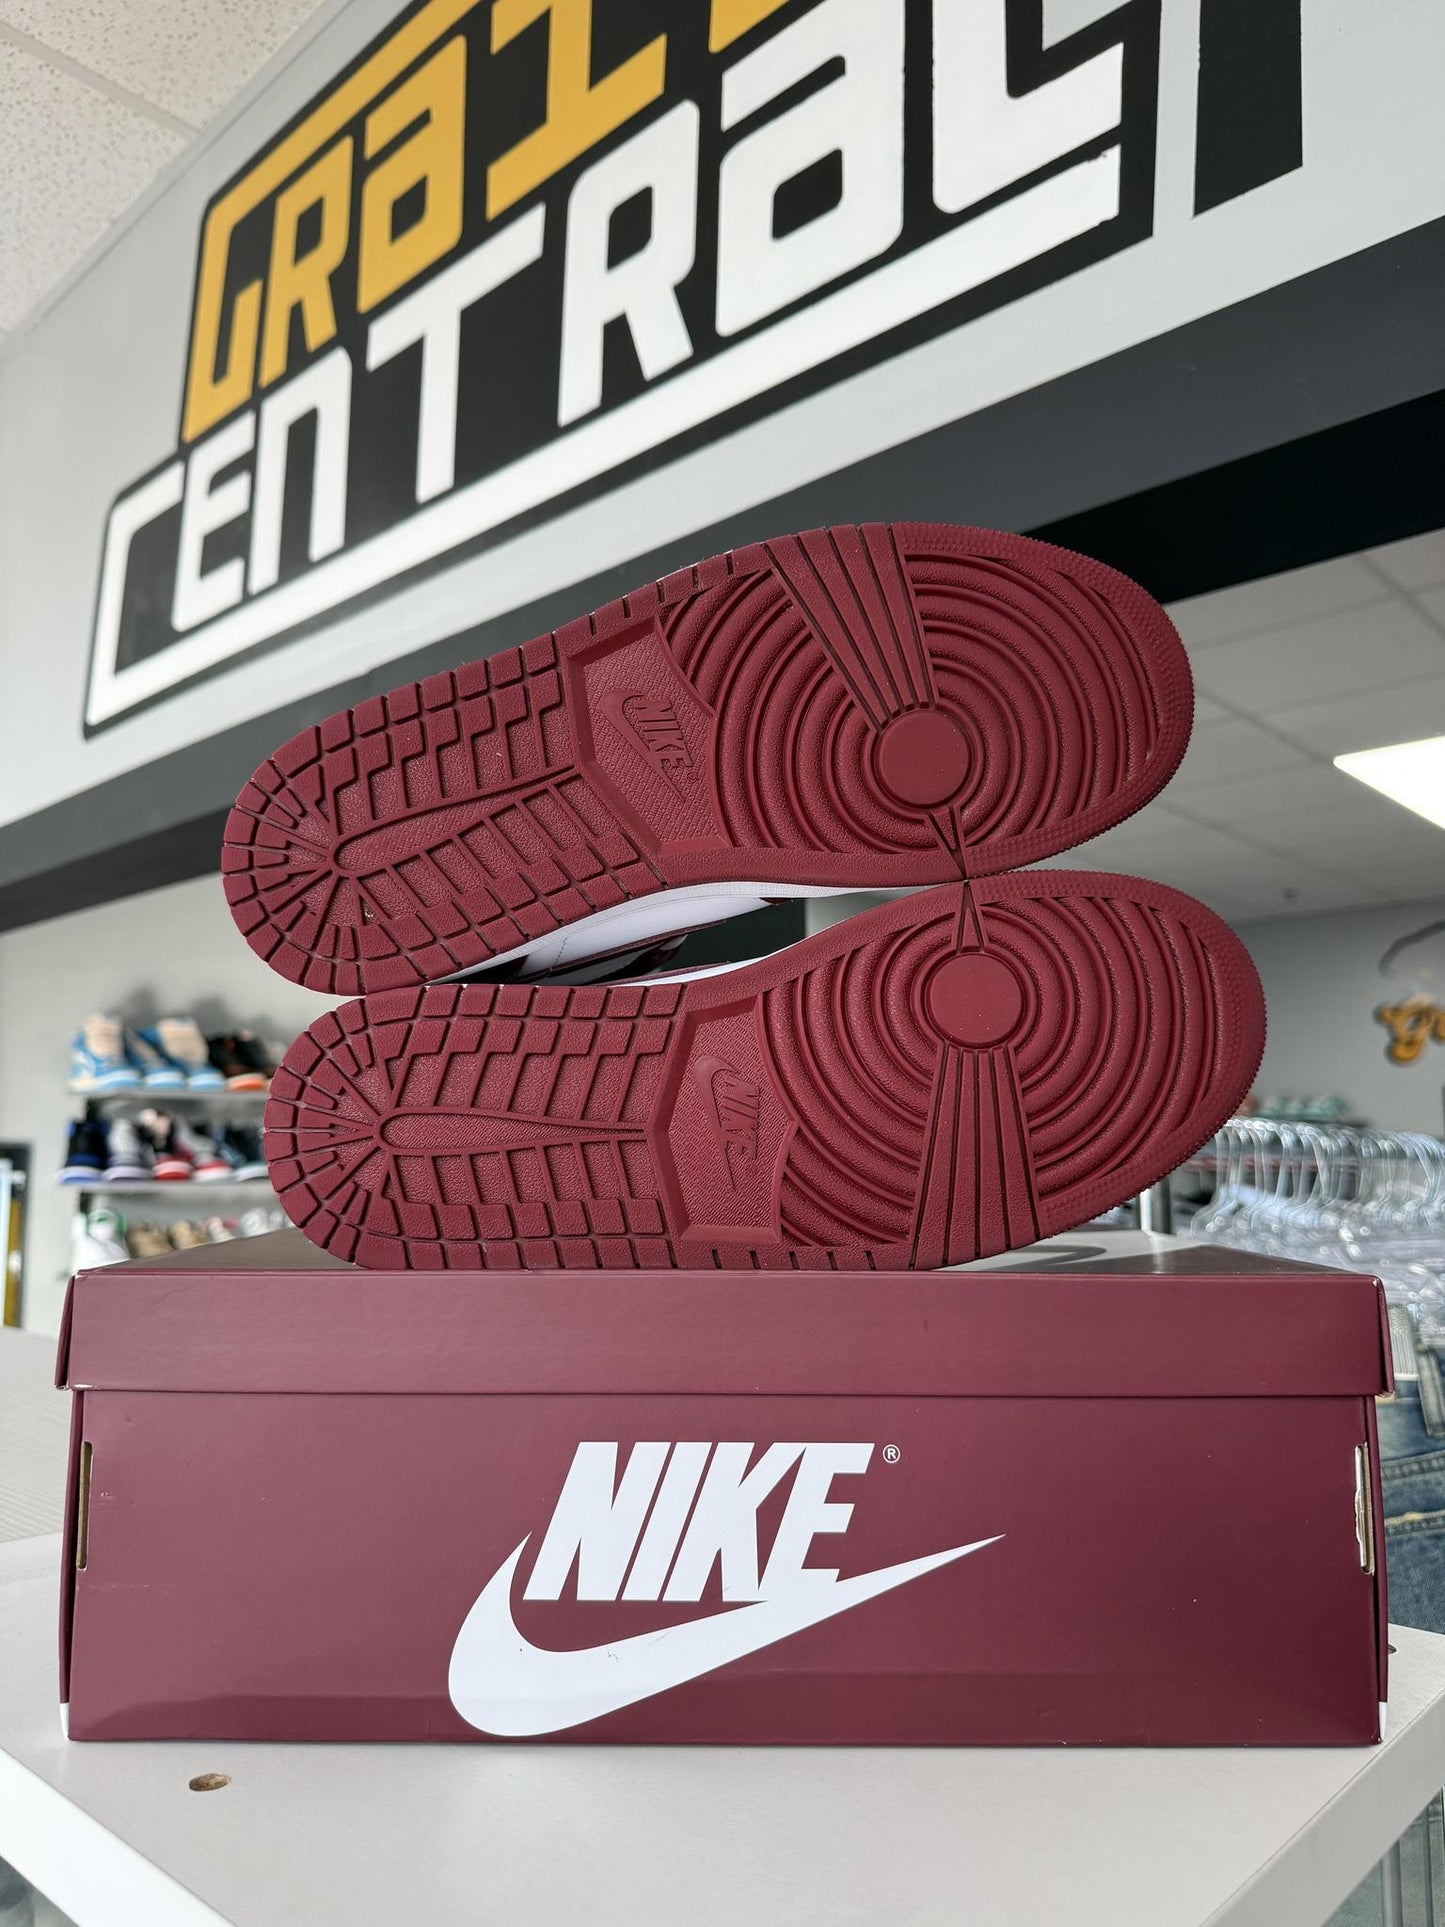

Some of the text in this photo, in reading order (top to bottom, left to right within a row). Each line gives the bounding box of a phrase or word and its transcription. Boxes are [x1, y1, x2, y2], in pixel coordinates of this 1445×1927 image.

[632, 697, 694, 769] NIKE
[721, 1071, 760, 1161] NIKE
[522, 1441, 875, 1602] NIKE
